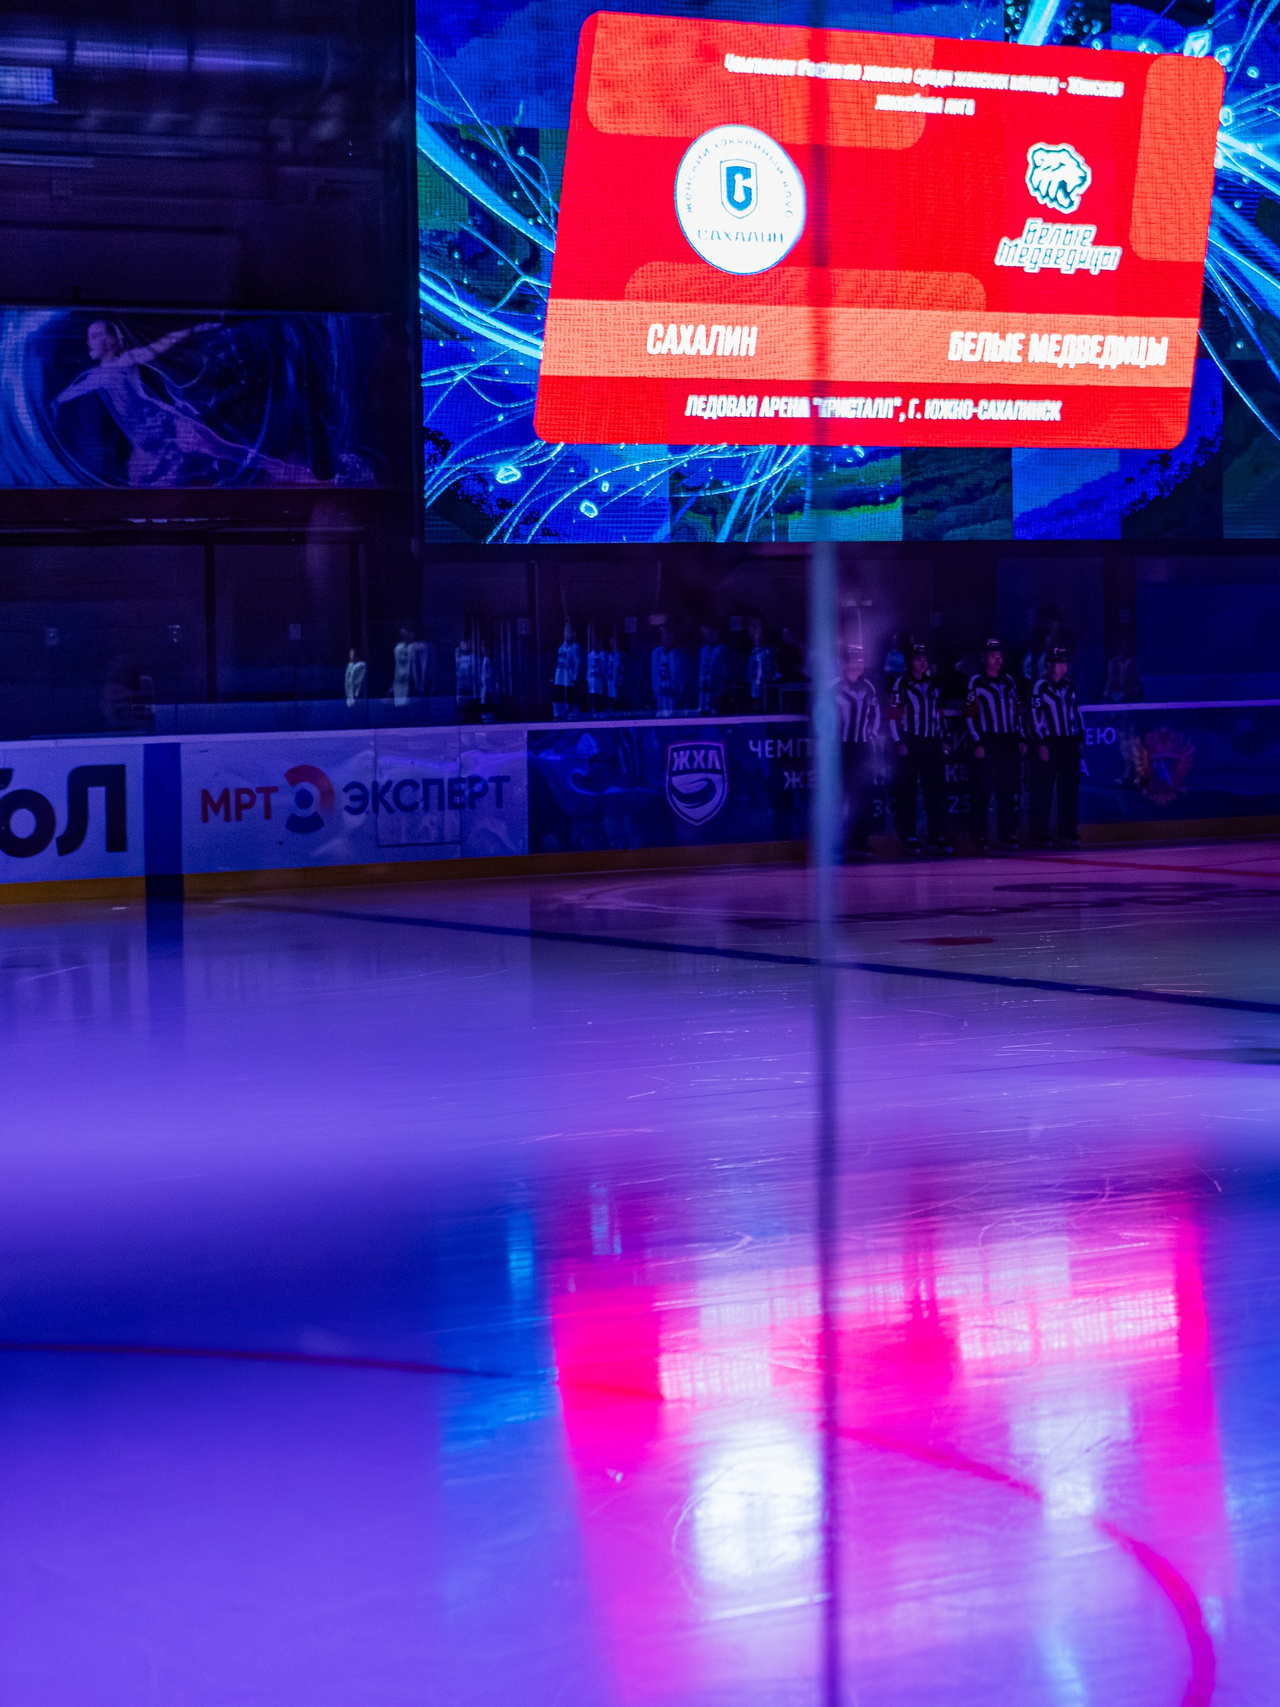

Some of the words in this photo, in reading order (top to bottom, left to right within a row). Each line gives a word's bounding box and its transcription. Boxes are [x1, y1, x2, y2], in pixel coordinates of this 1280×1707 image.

[646, 323, 758, 357] САХАЛИН
[948, 331, 1026, 363] БЕЛЫЕ
[1027, 333, 1169, 370] МЕДВЕДИЦЫ
[684, 394, 758, 420] ЛЕДОВАЯ
[759, 395, 811, 418] АРЕНА
[908, 398, 922, 420] Г.
[924, 399, 1063, 422] ЮЖНО-САХАЛИНСК
[672, 749, 722, 772] ЖХЛ
[201, 785, 279, 823] МРТ
[342, 775, 511, 815] ЭКСПЕРТ
